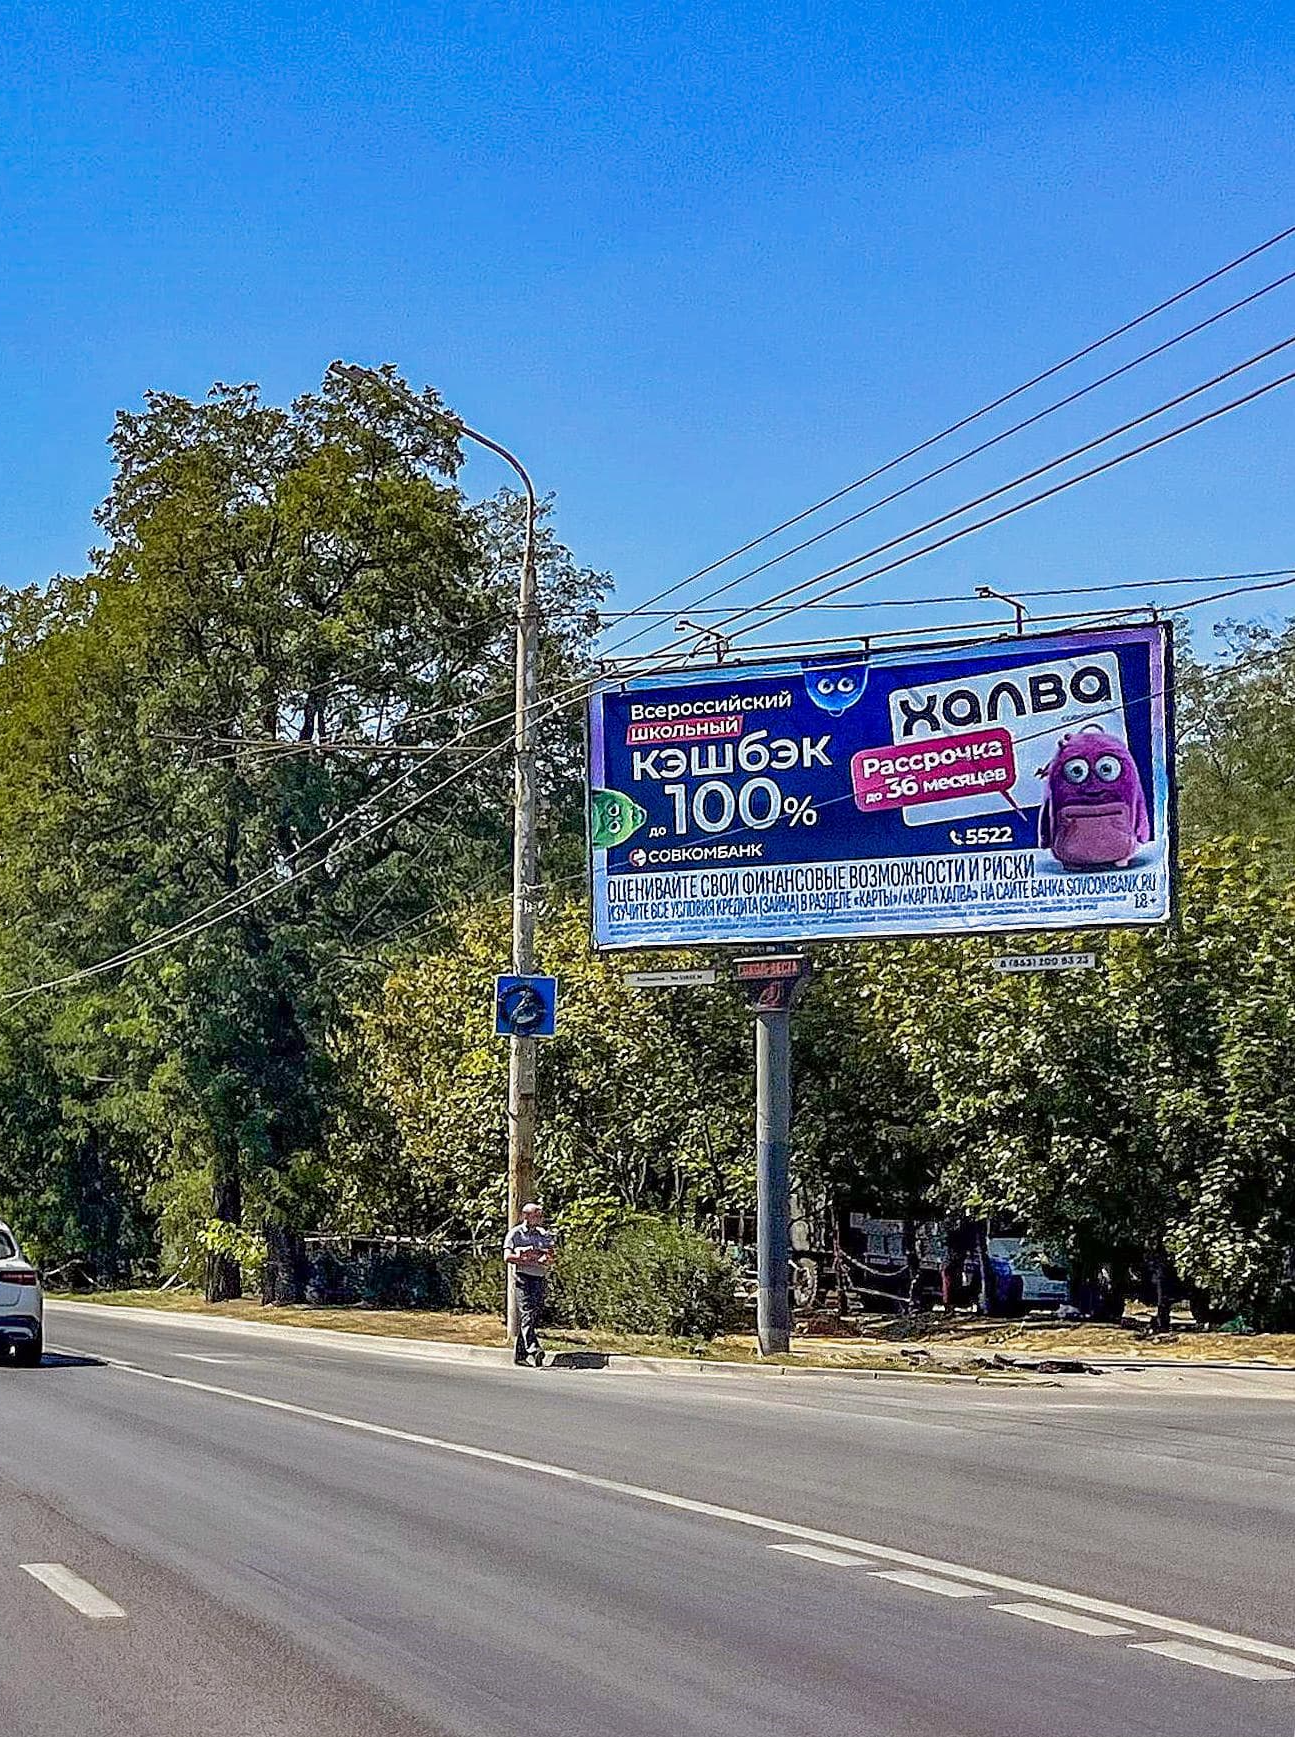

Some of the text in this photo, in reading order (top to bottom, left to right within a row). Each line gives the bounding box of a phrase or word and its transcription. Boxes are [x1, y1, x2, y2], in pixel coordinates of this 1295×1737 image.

[631, 690, 792, 721] Всероссийский
[863, 739, 1003, 778] Рассрочка
[865, 767, 1007, 804] до 36 месяцев
[648, 826, 667, 838] до
[965, 826, 1012, 844] 5522
[648, 844, 763, 864] СОВКОМБАНК
[608, 854, 1035, 904] ОЦЕНИВАЙТЕ СВОИ ФИНАНСОВЫЕ ВОЗМОЖНОСТИ И РИСКИ
